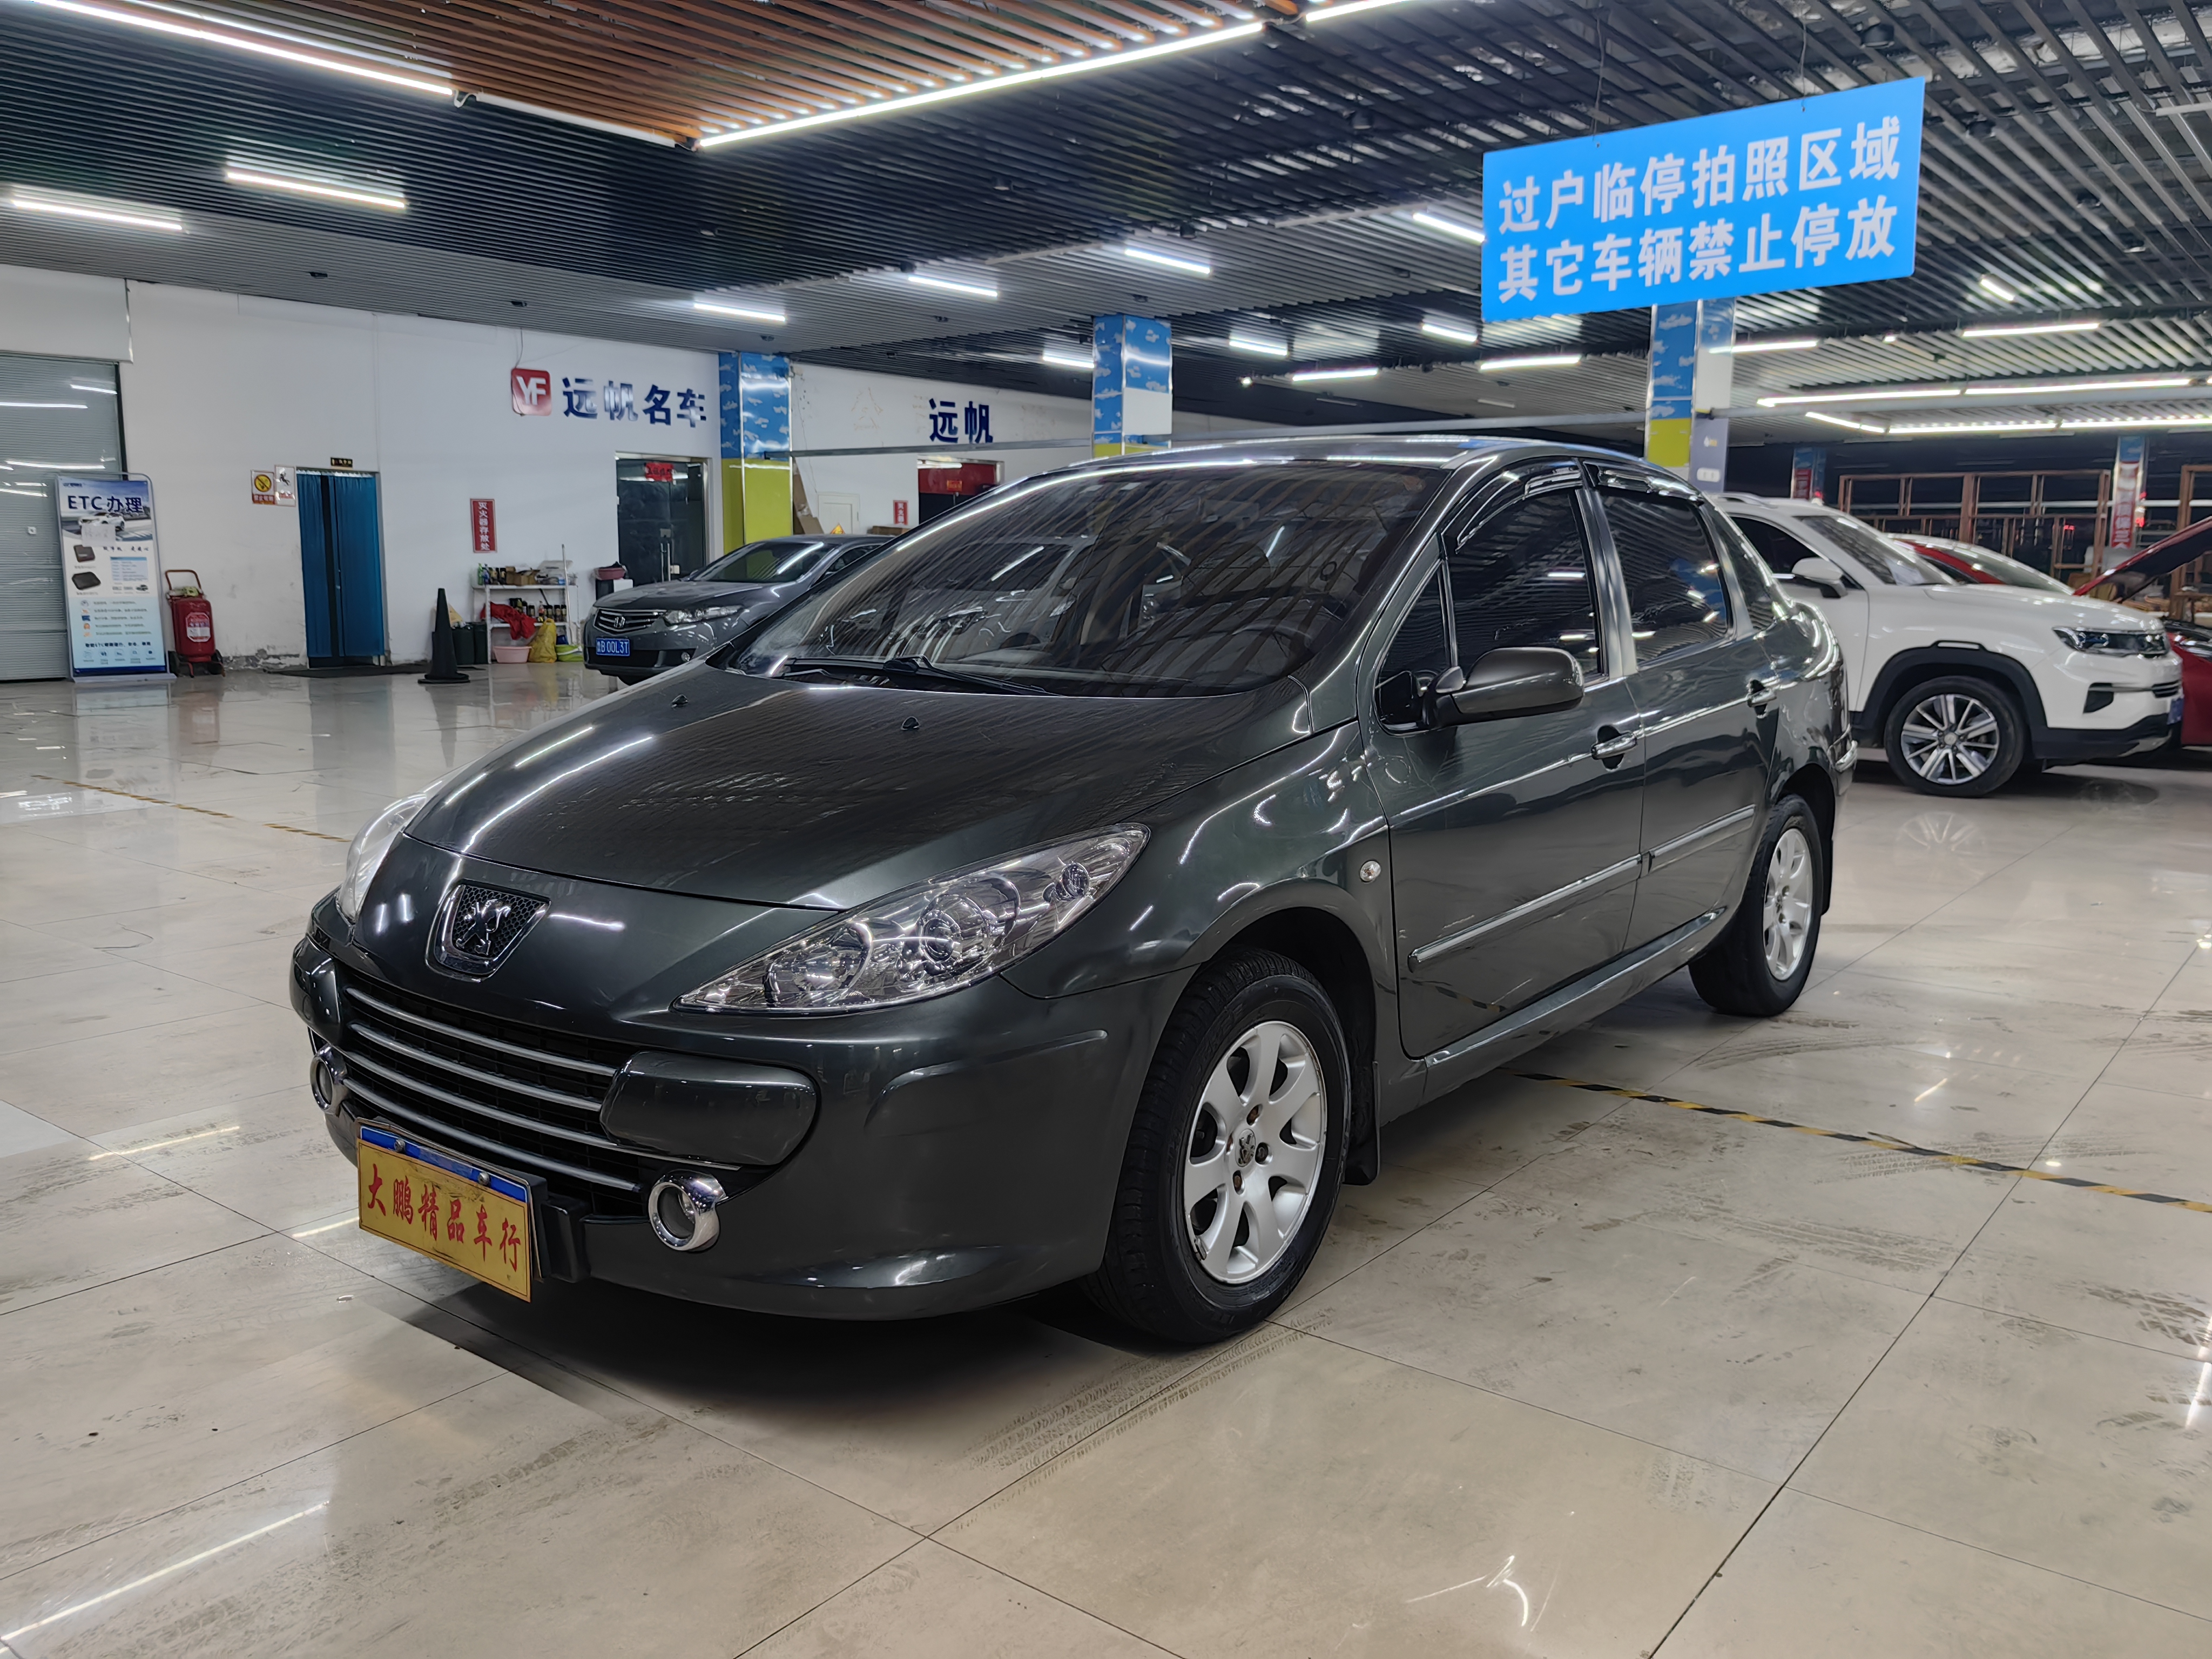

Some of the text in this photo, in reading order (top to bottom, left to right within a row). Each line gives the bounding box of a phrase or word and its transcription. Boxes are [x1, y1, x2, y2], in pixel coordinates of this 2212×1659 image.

[1498, 115, 1900, 235] 过户临停拍照区域
[1498, 195, 1898, 304] 其它车辆禁止停放
[562, 377, 706, 428] 远帆名车
[929, 398, 993, 443] 远帆
